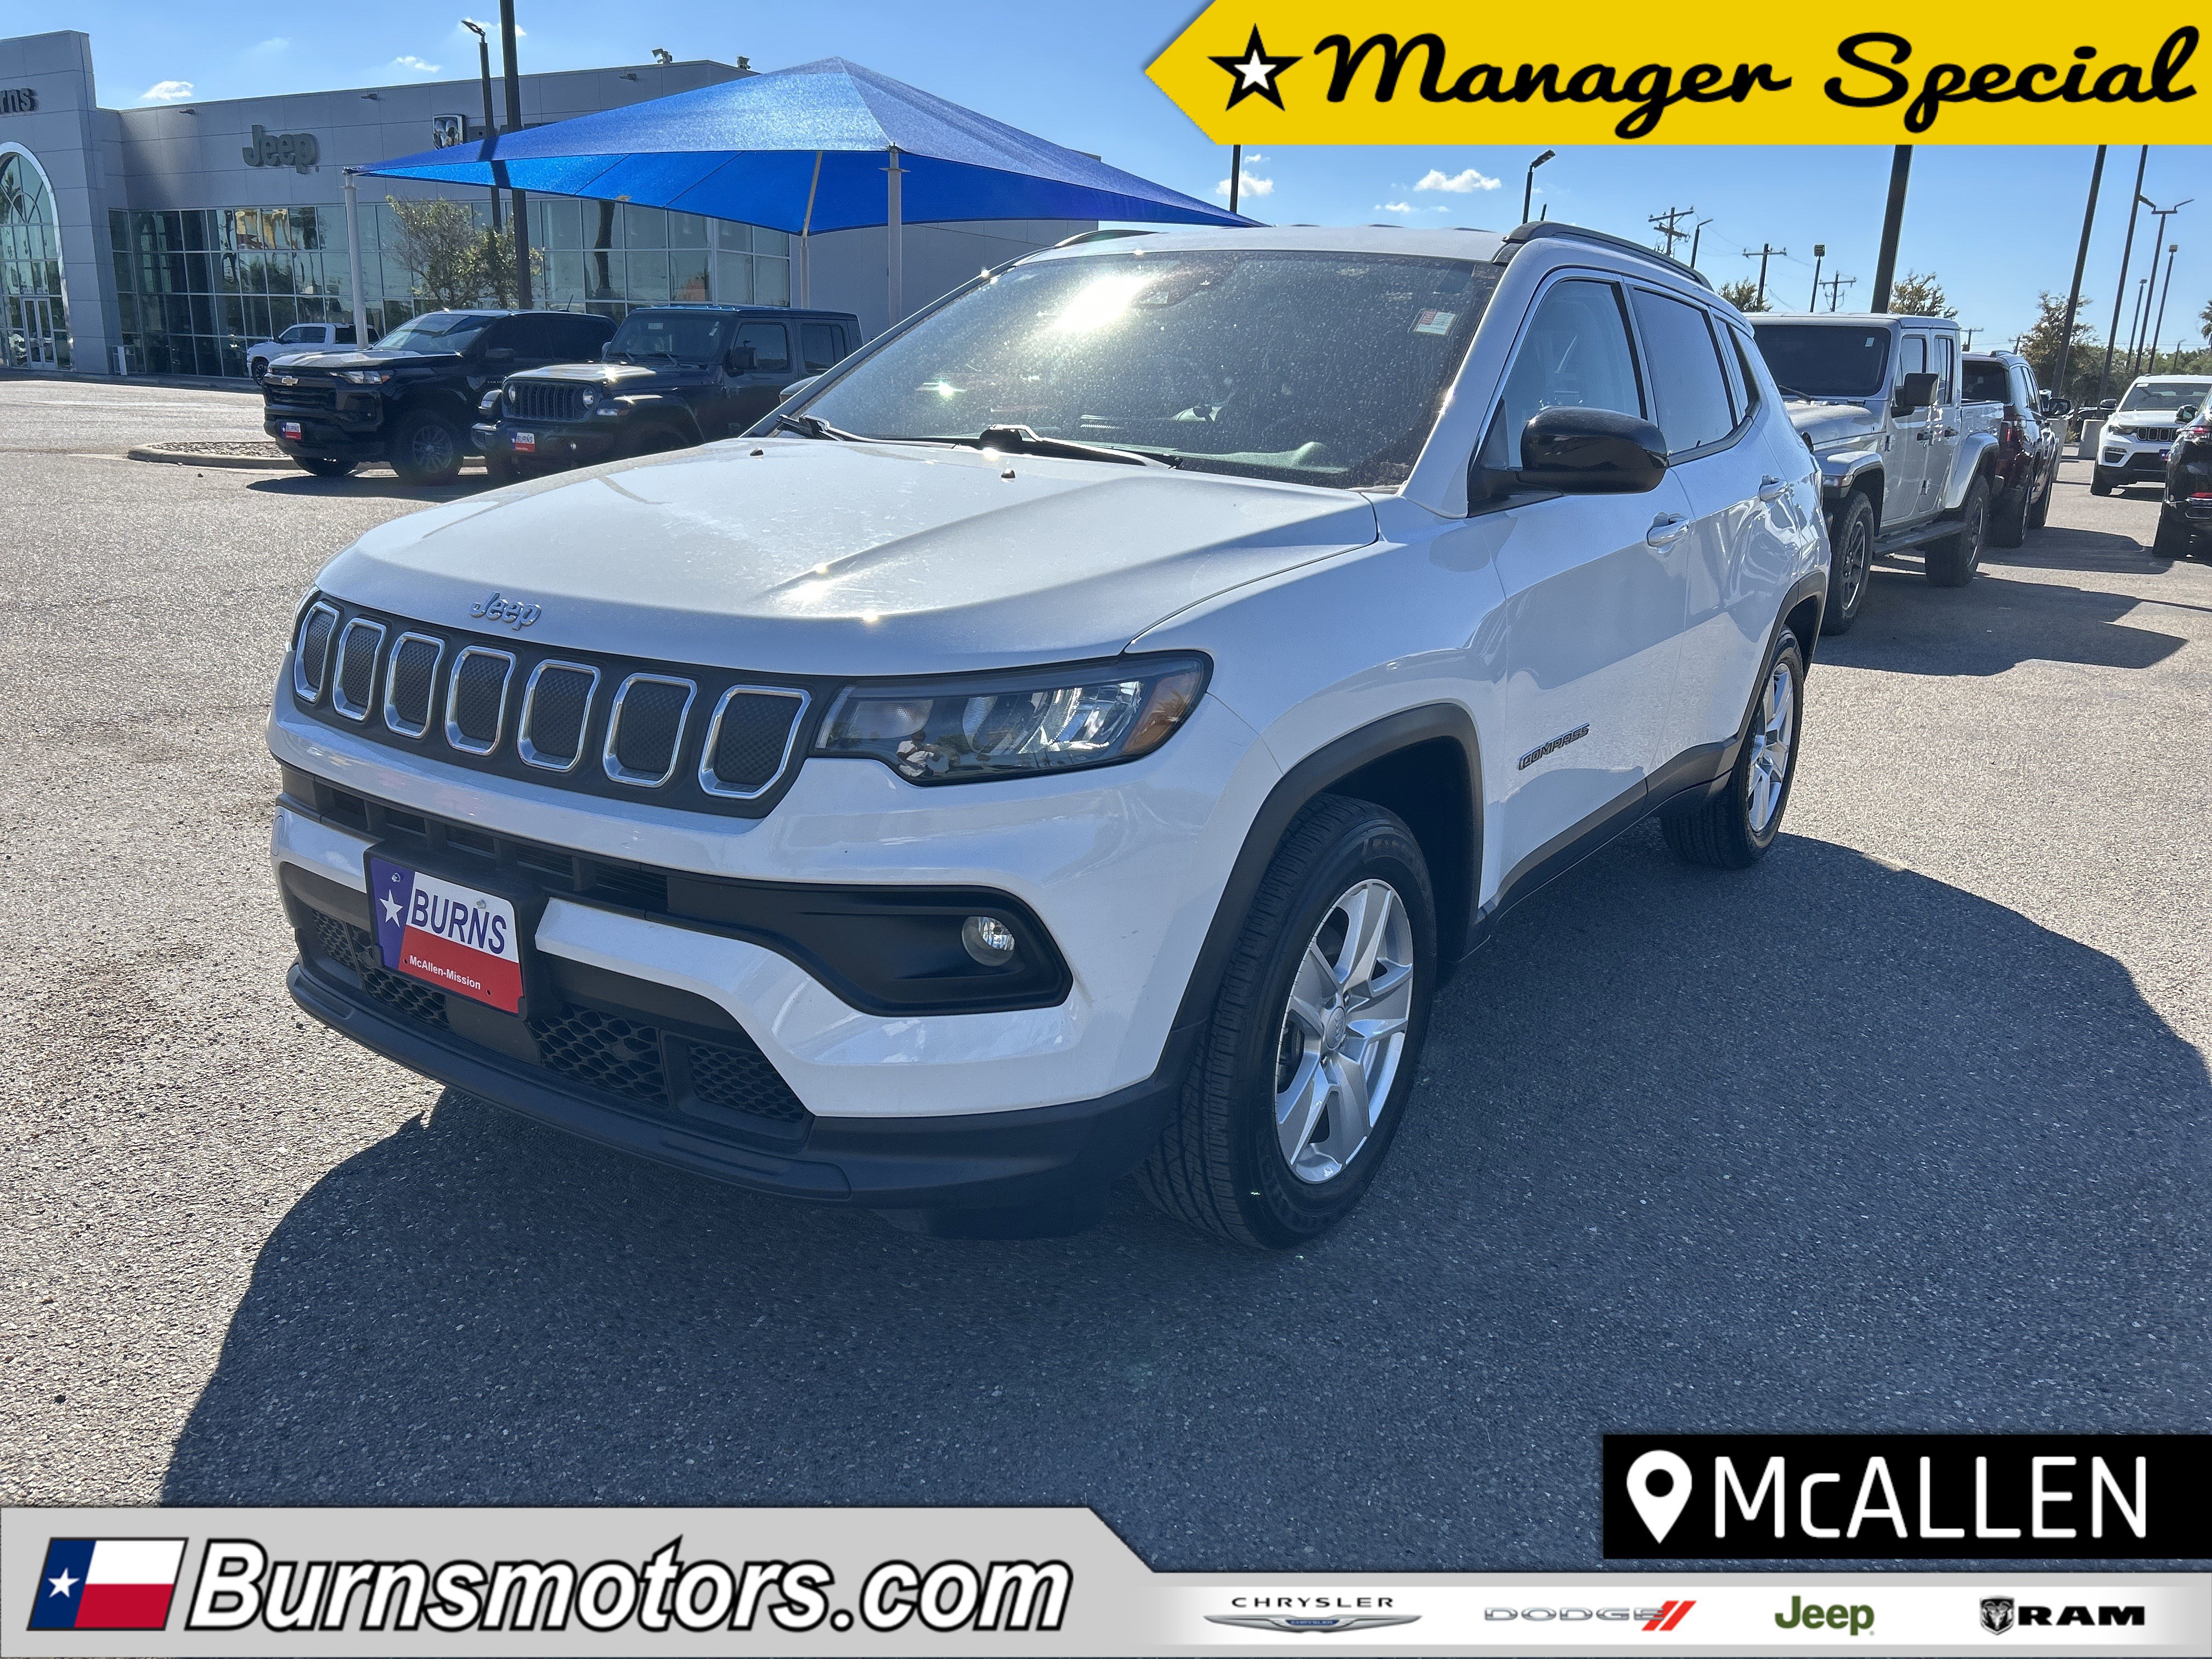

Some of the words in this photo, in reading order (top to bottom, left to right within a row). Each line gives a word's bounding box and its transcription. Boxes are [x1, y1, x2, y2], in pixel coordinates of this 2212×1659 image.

[242, 125, 318, 174] Jeep
[470, 591, 542, 631] Jeep
[1518, 723, 1590, 770] COMPASS
[411, 888, 507, 955] BURNS
[409, 955, 481, 990] McAllen-Mission
